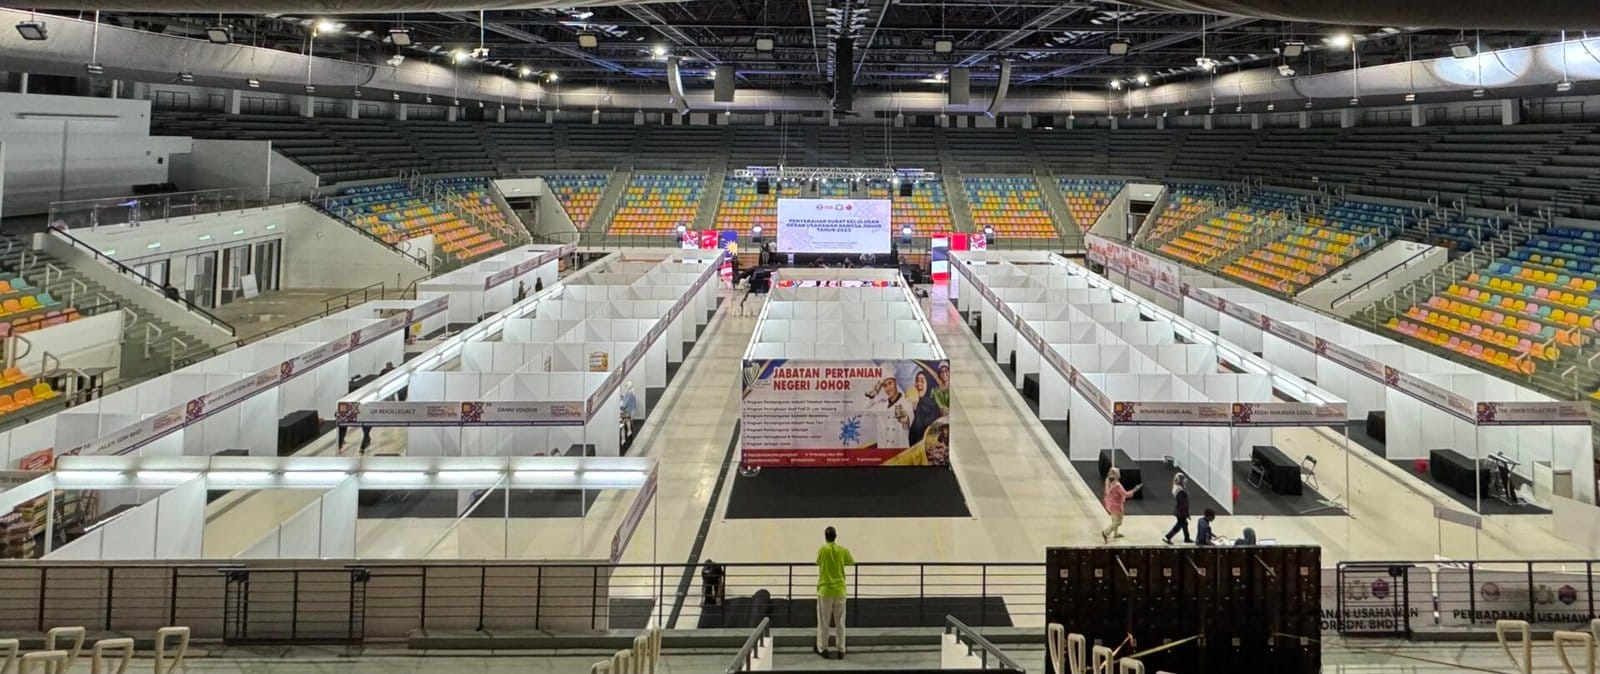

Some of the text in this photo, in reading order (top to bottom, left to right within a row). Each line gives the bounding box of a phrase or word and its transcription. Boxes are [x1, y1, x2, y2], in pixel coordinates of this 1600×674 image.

[773, 368, 883, 379] JABATAN PERTANIAN
[773, 380, 811, 391] NEGERI
[815, 380, 850, 391] JOHOR
